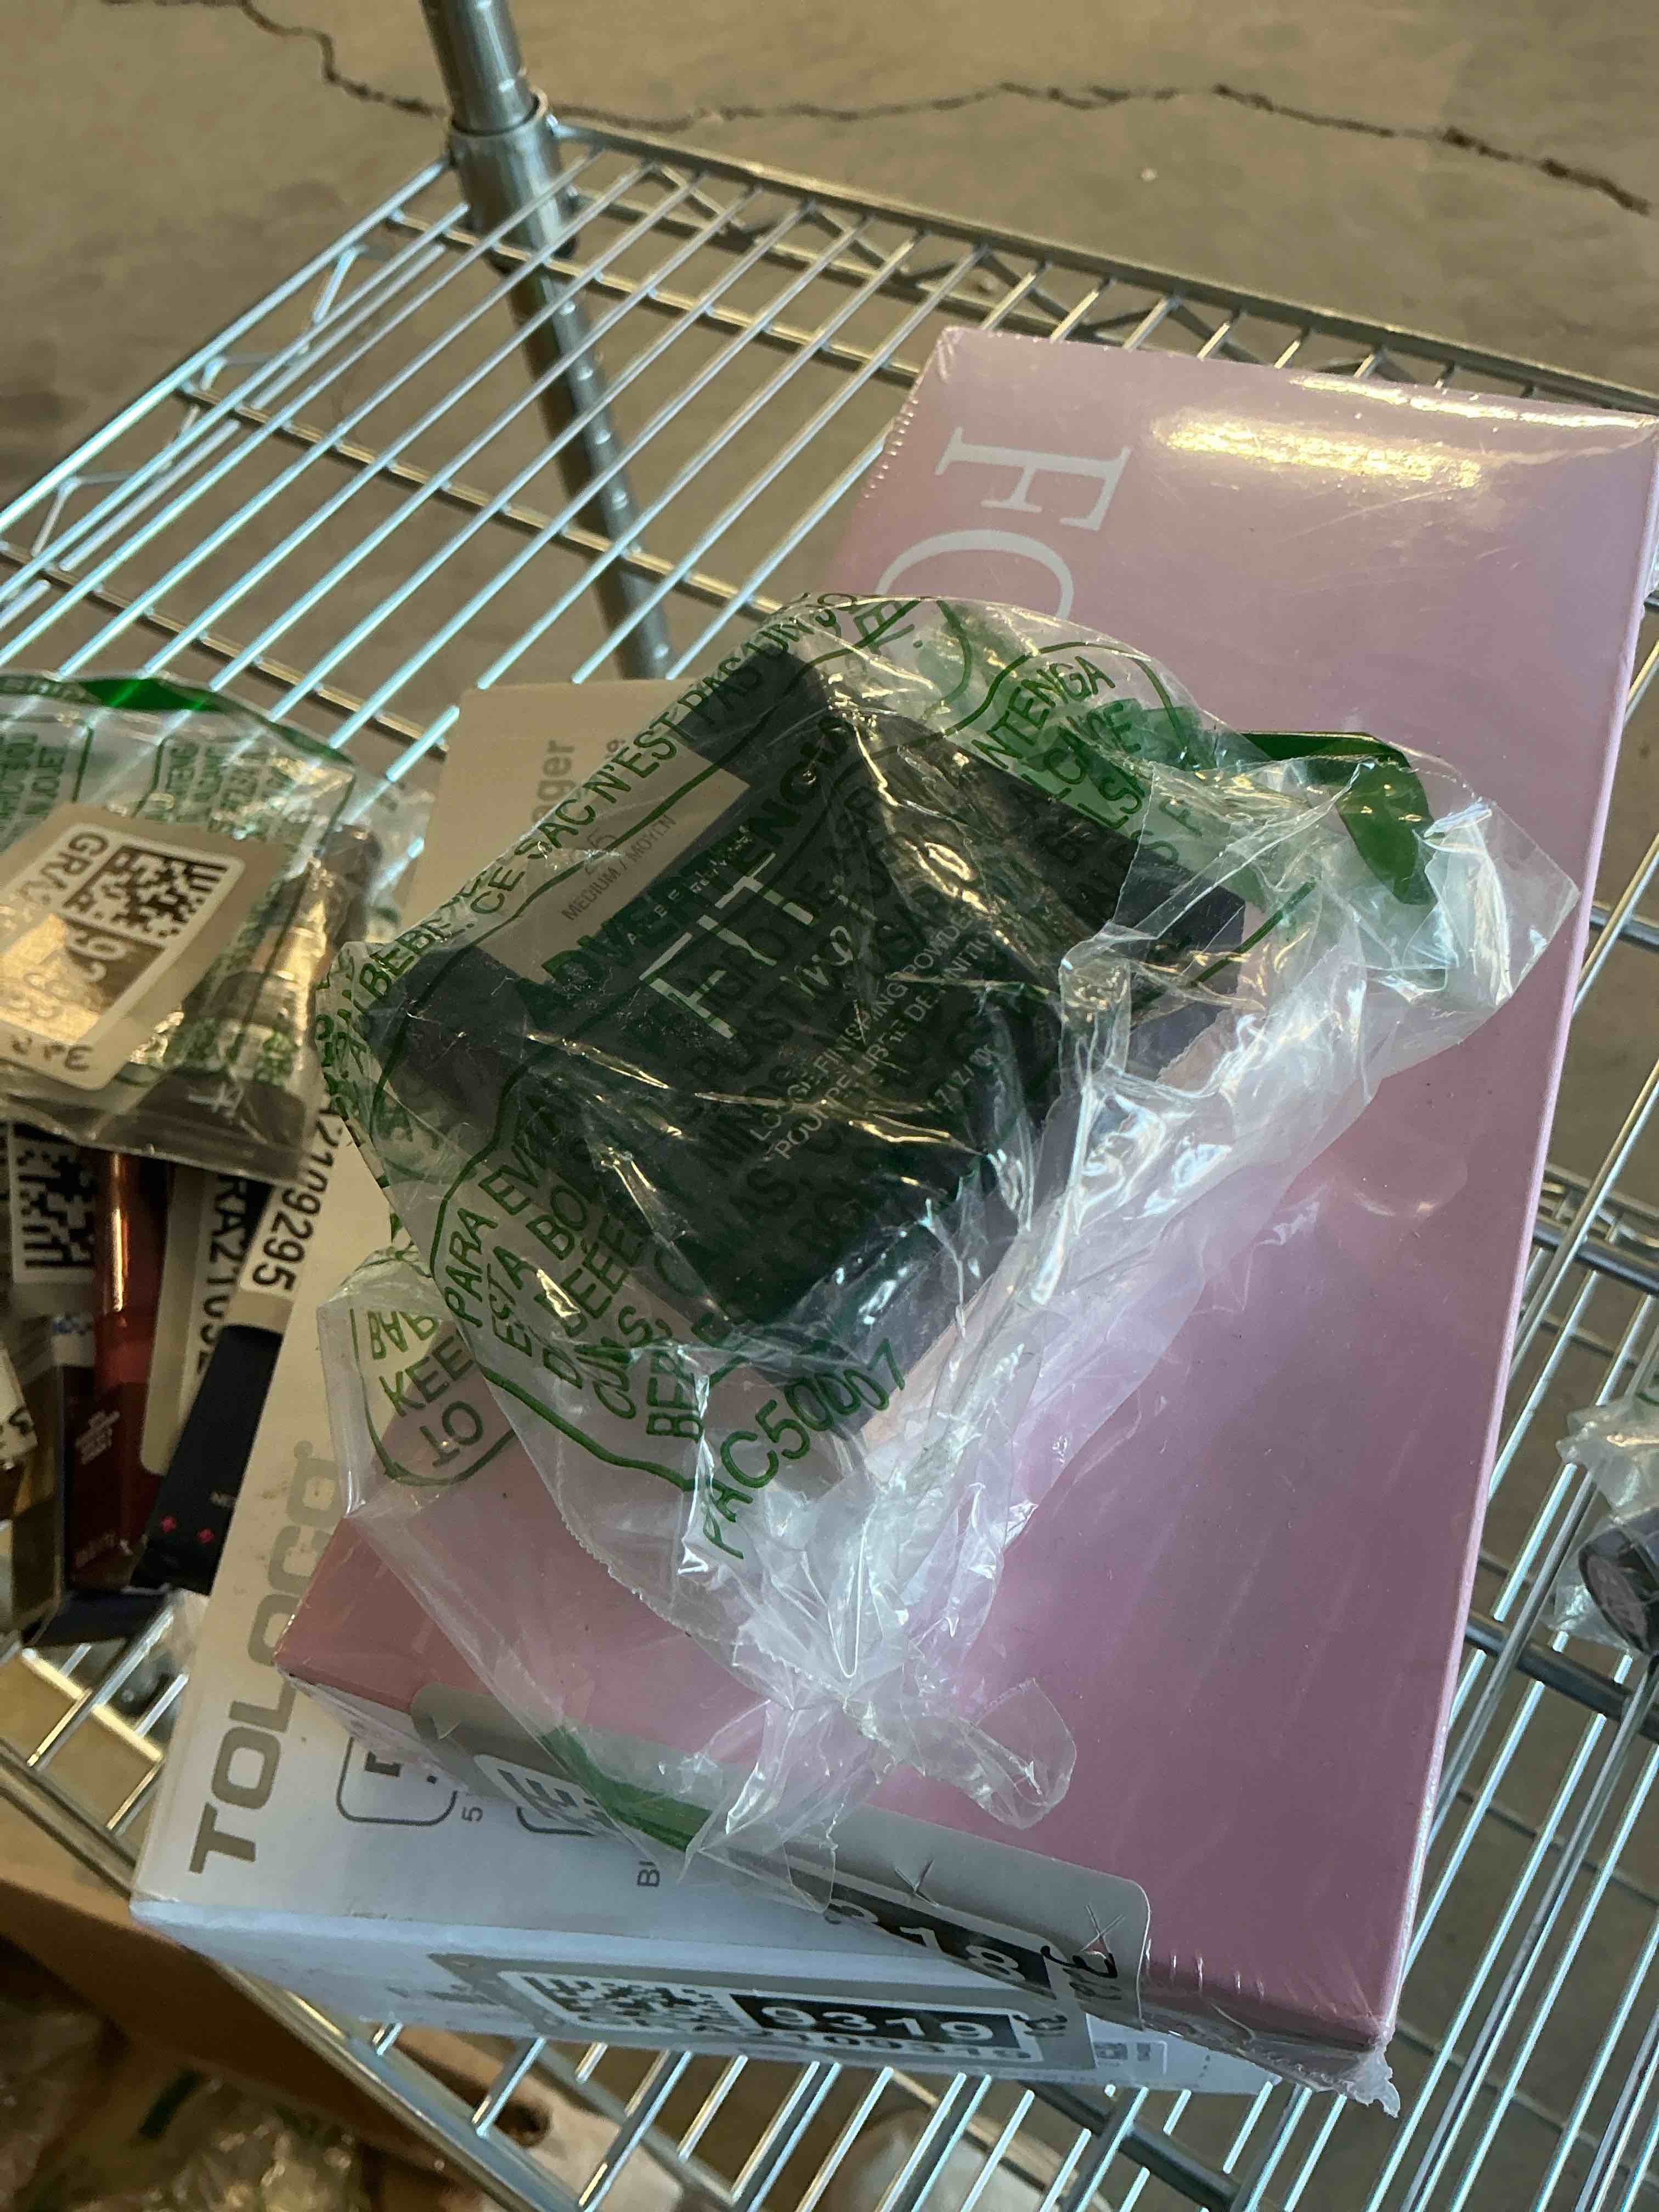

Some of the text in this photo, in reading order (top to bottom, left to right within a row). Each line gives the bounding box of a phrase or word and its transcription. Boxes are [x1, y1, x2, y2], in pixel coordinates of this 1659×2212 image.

[579, 708, 693, 818] N'EST
[559, 864, 623, 924] MEDIUM
[444, 1206, 498, 1327] PARA
[970, 654, 1116, 769] NTENGA
[635, 849, 848, 1057] FIT
[896, 903, 983, 986] POWDE
[761, 2005, 994, 2041] 9319
